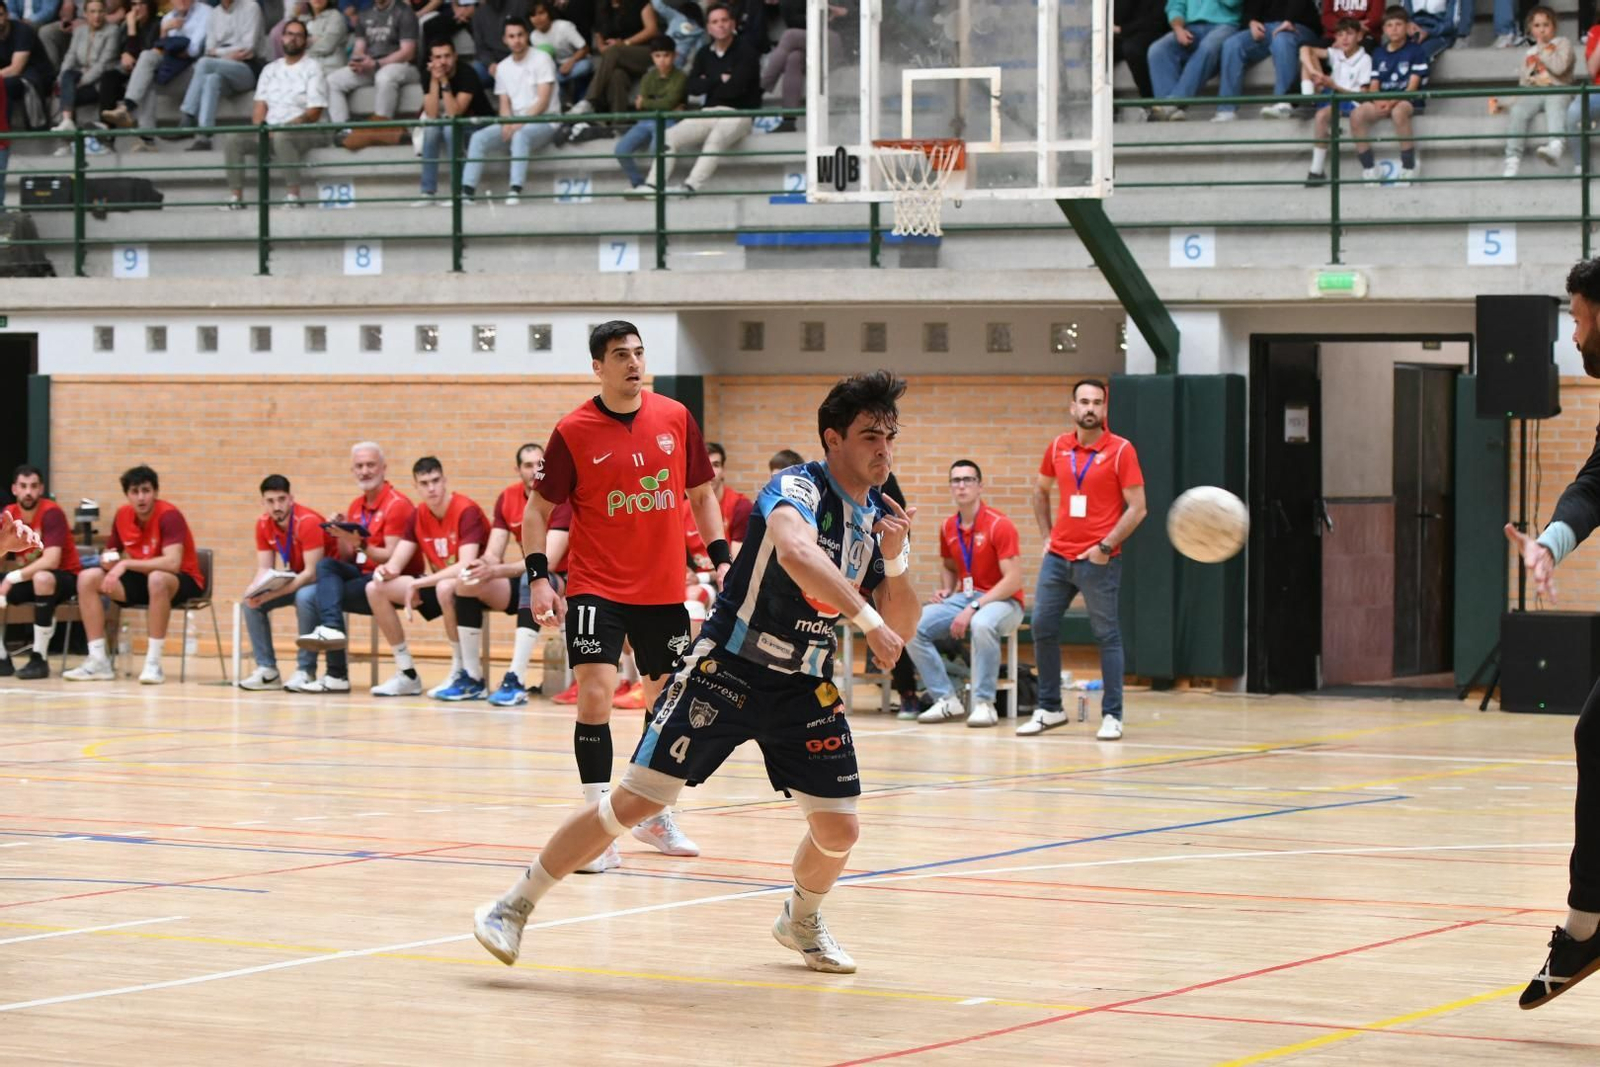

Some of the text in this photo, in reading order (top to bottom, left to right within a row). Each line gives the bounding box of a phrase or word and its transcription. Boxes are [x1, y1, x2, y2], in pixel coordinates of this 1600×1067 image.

[817, 146, 860, 192] WOB
[322, 184, 352, 206] 28
[558, 179, 589, 201] 27
[611, 242, 627, 265] 7
[1184, 234, 1201, 260] 6
[1485, 229, 1501, 255] 5
[123, 248, 138, 271] 9
[356, 245, 370, 267] 8
[632, 452, 645, 467] 11
[607, 489, 675, 517] Proin
[848, 539, 864, 571] 4
[578, 605, 596, 635] 11
[669, 735, 691, 764] 4
